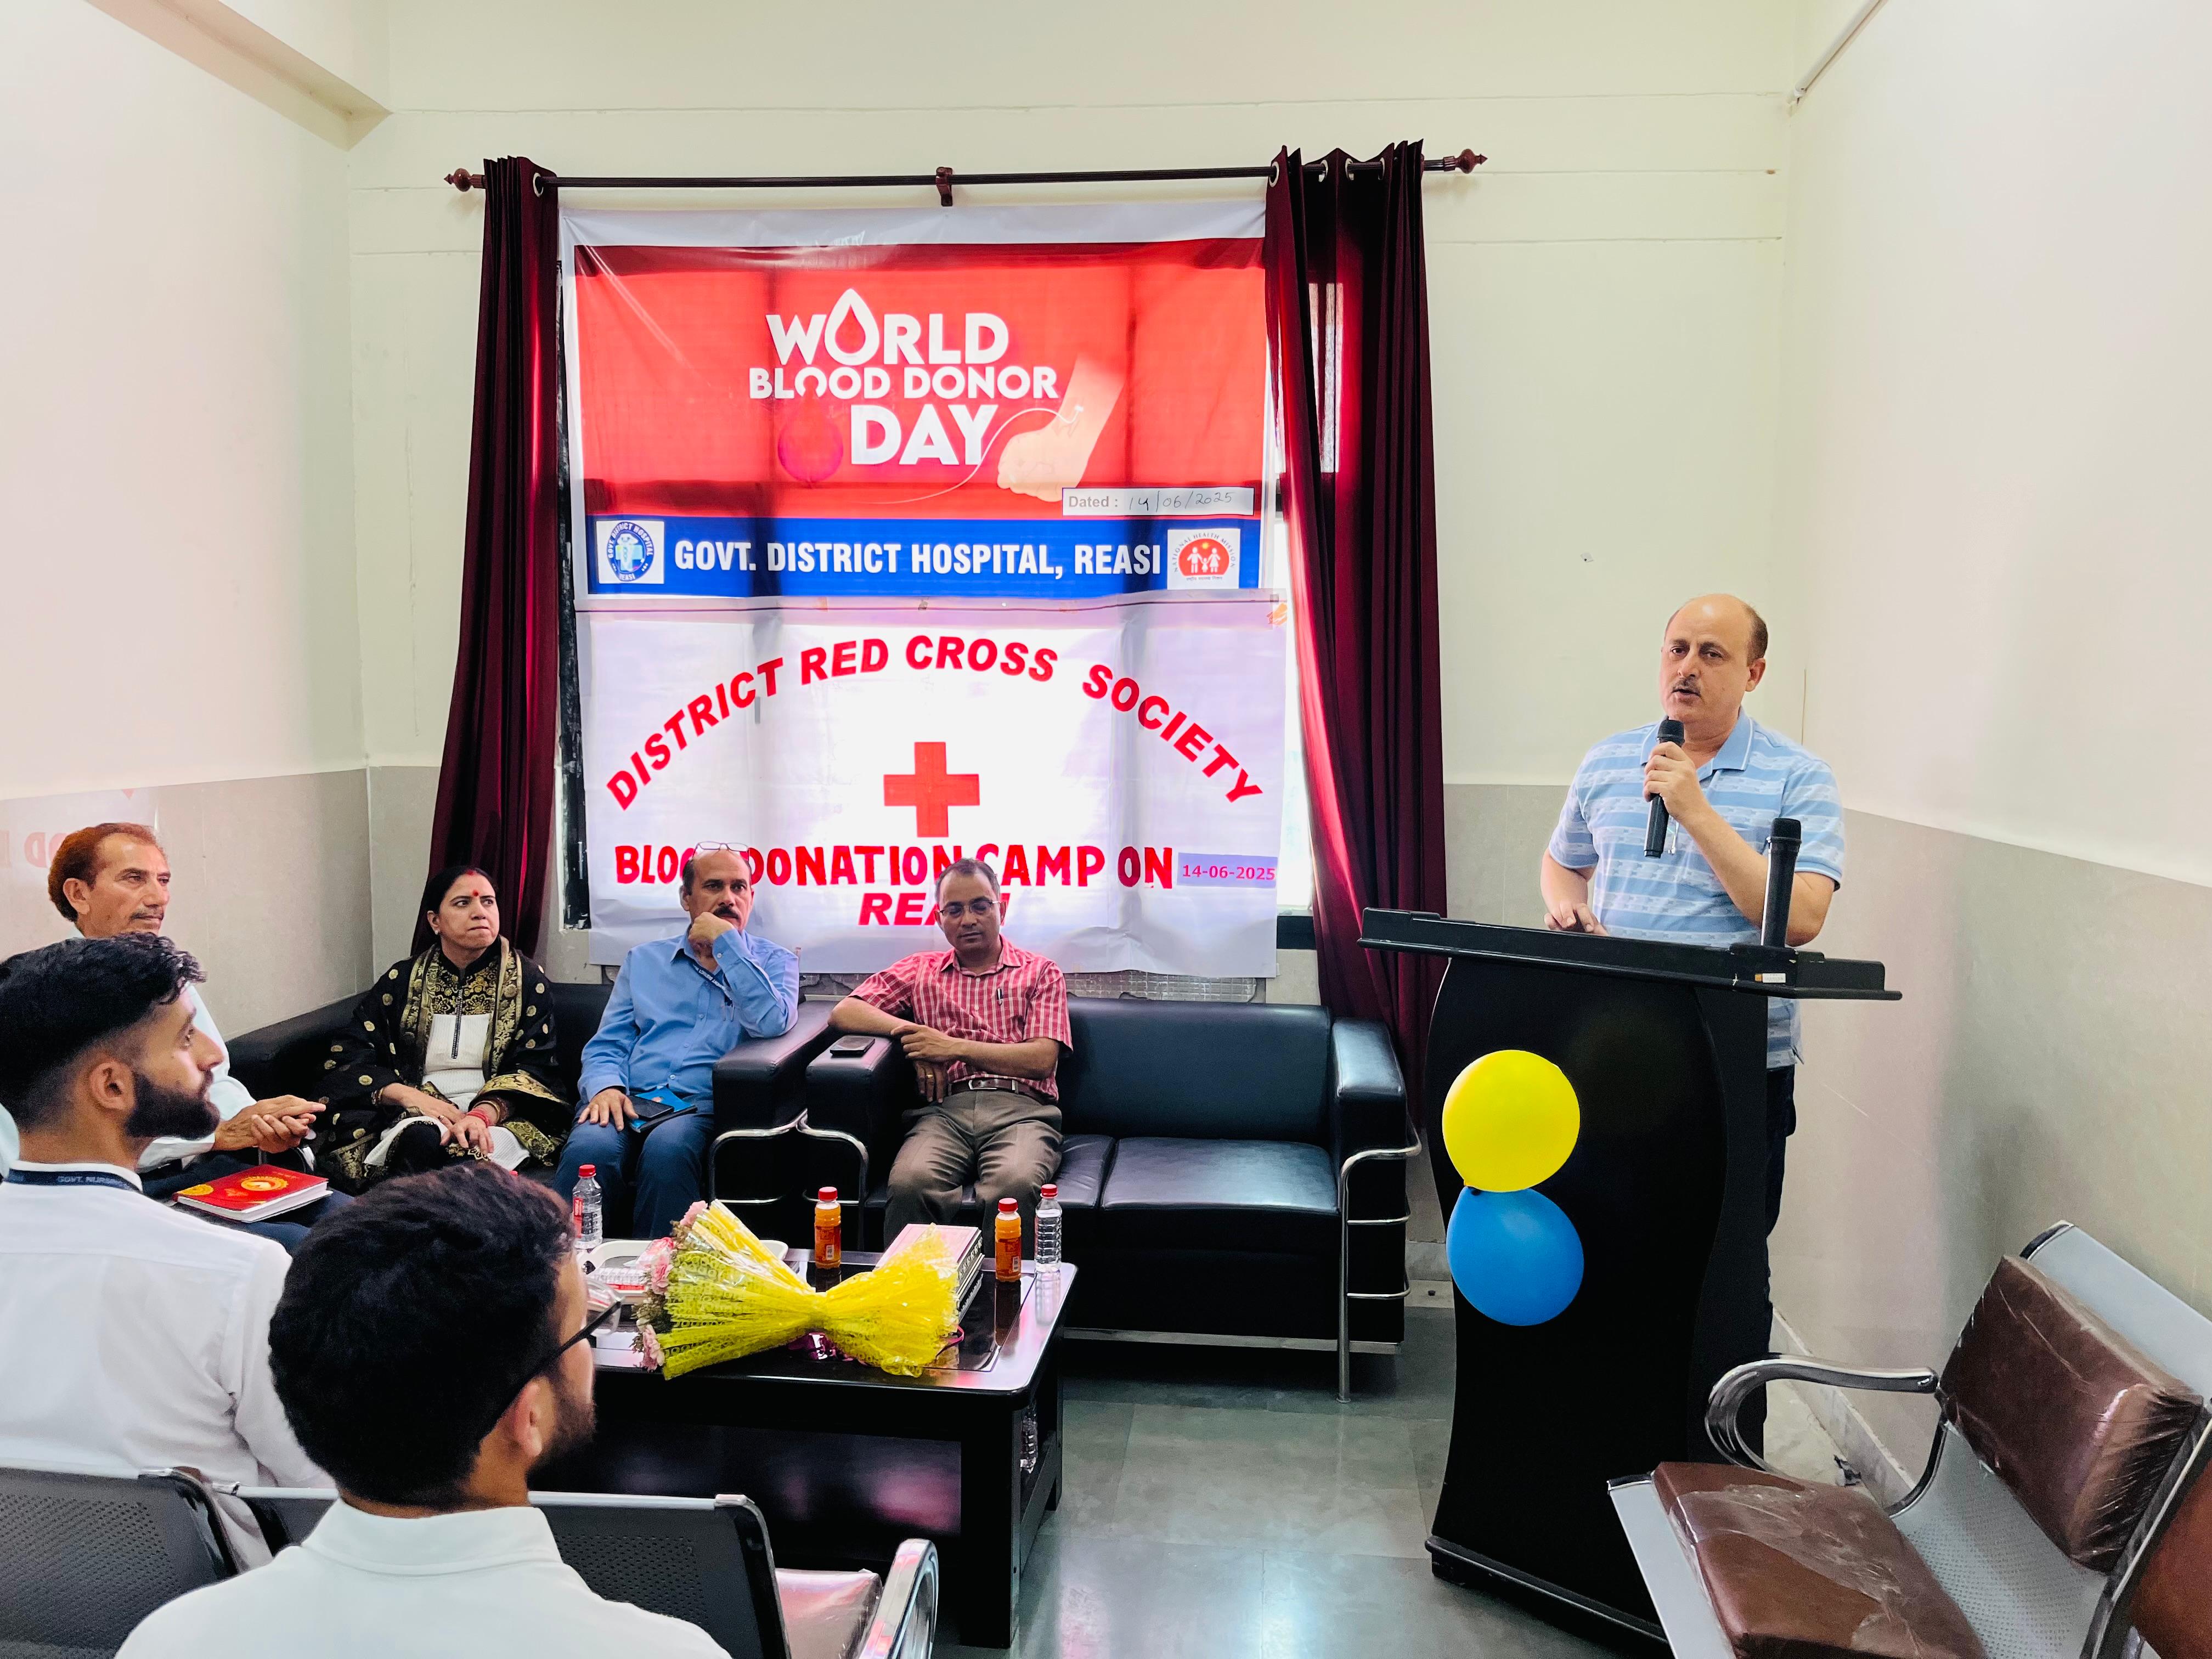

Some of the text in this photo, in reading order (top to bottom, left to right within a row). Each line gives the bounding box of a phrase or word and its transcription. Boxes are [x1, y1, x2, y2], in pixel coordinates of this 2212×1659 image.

[765, 288, 1009, 366] WORLD
[749, 366, 1059, 399] BLOOD DONOR
[850, 404, 998, 466] DAY
[1069, 495, 1109, 507] Dated
[633, 526, 654, 556] HOSPITAL
[674, 540, 1160, 579] GOVT. DISTRICT HOSPITAL, REASI
[1172, 537, 1192, 572] NATIONAL
[1220, 538, 1236, 567] MISSION
[606, 635, 1263, 811] DISTRICT RED CROSS SOCIETY
[614, 845, 698, 884] BLO
[1117, 845, 1173, 889] ON
[1182, 864, 1276, 881] 14-06-2025
